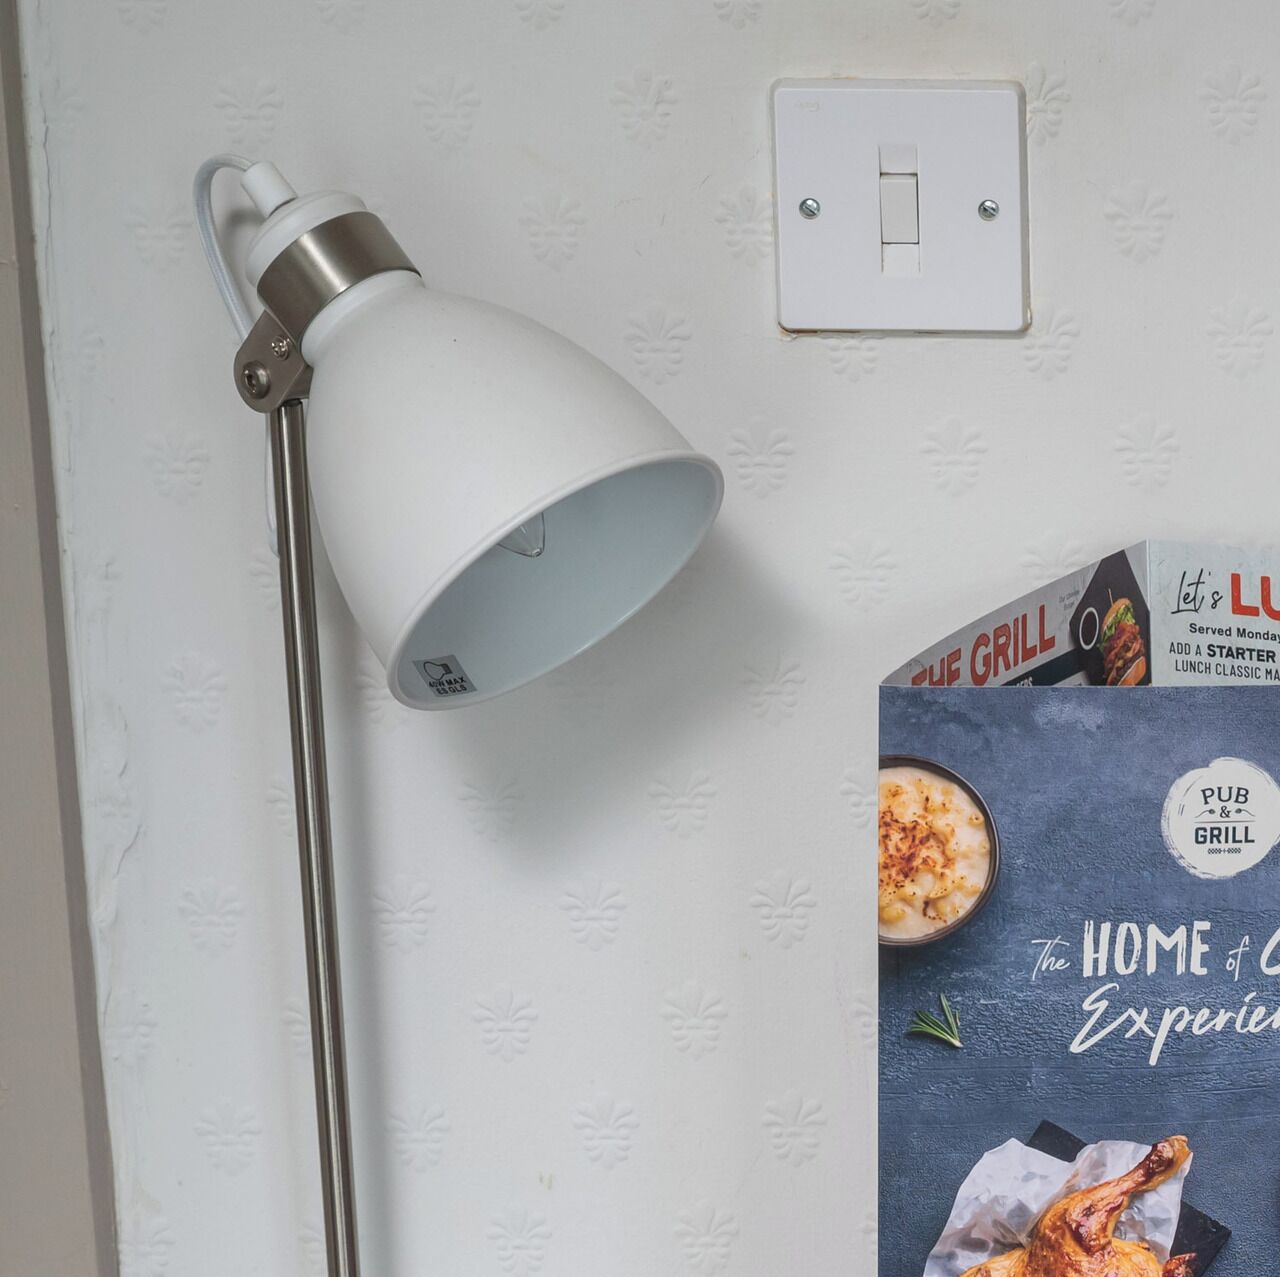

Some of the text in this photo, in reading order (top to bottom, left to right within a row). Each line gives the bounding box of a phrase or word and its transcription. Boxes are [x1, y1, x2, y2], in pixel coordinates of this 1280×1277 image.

[1171, 568, 1223, 614] Let's
[1189, 622, 1232, 637] Served
[970, 603, 1056, 686] GRILL
[1169, 642, 1190, 655] ADD
[1195, 644, 1201, 655] A
[1207, 644, 1275, 663] STARTER
[1175, 659, 1210, 674] LUNCH
[1215, 663, 1260, 679] CLASSIC
[446, 676, 466, 686] MAX
[1200, 786, 1249, 805] PUB
[1219, 805, 1232, 818] &
[1195, 826, 1255, 844] GRILL
[1031, 936, 1071, 981] The
[1081, 920, 1211, 977] HOME
[1225, 935, 1249, 981] of
